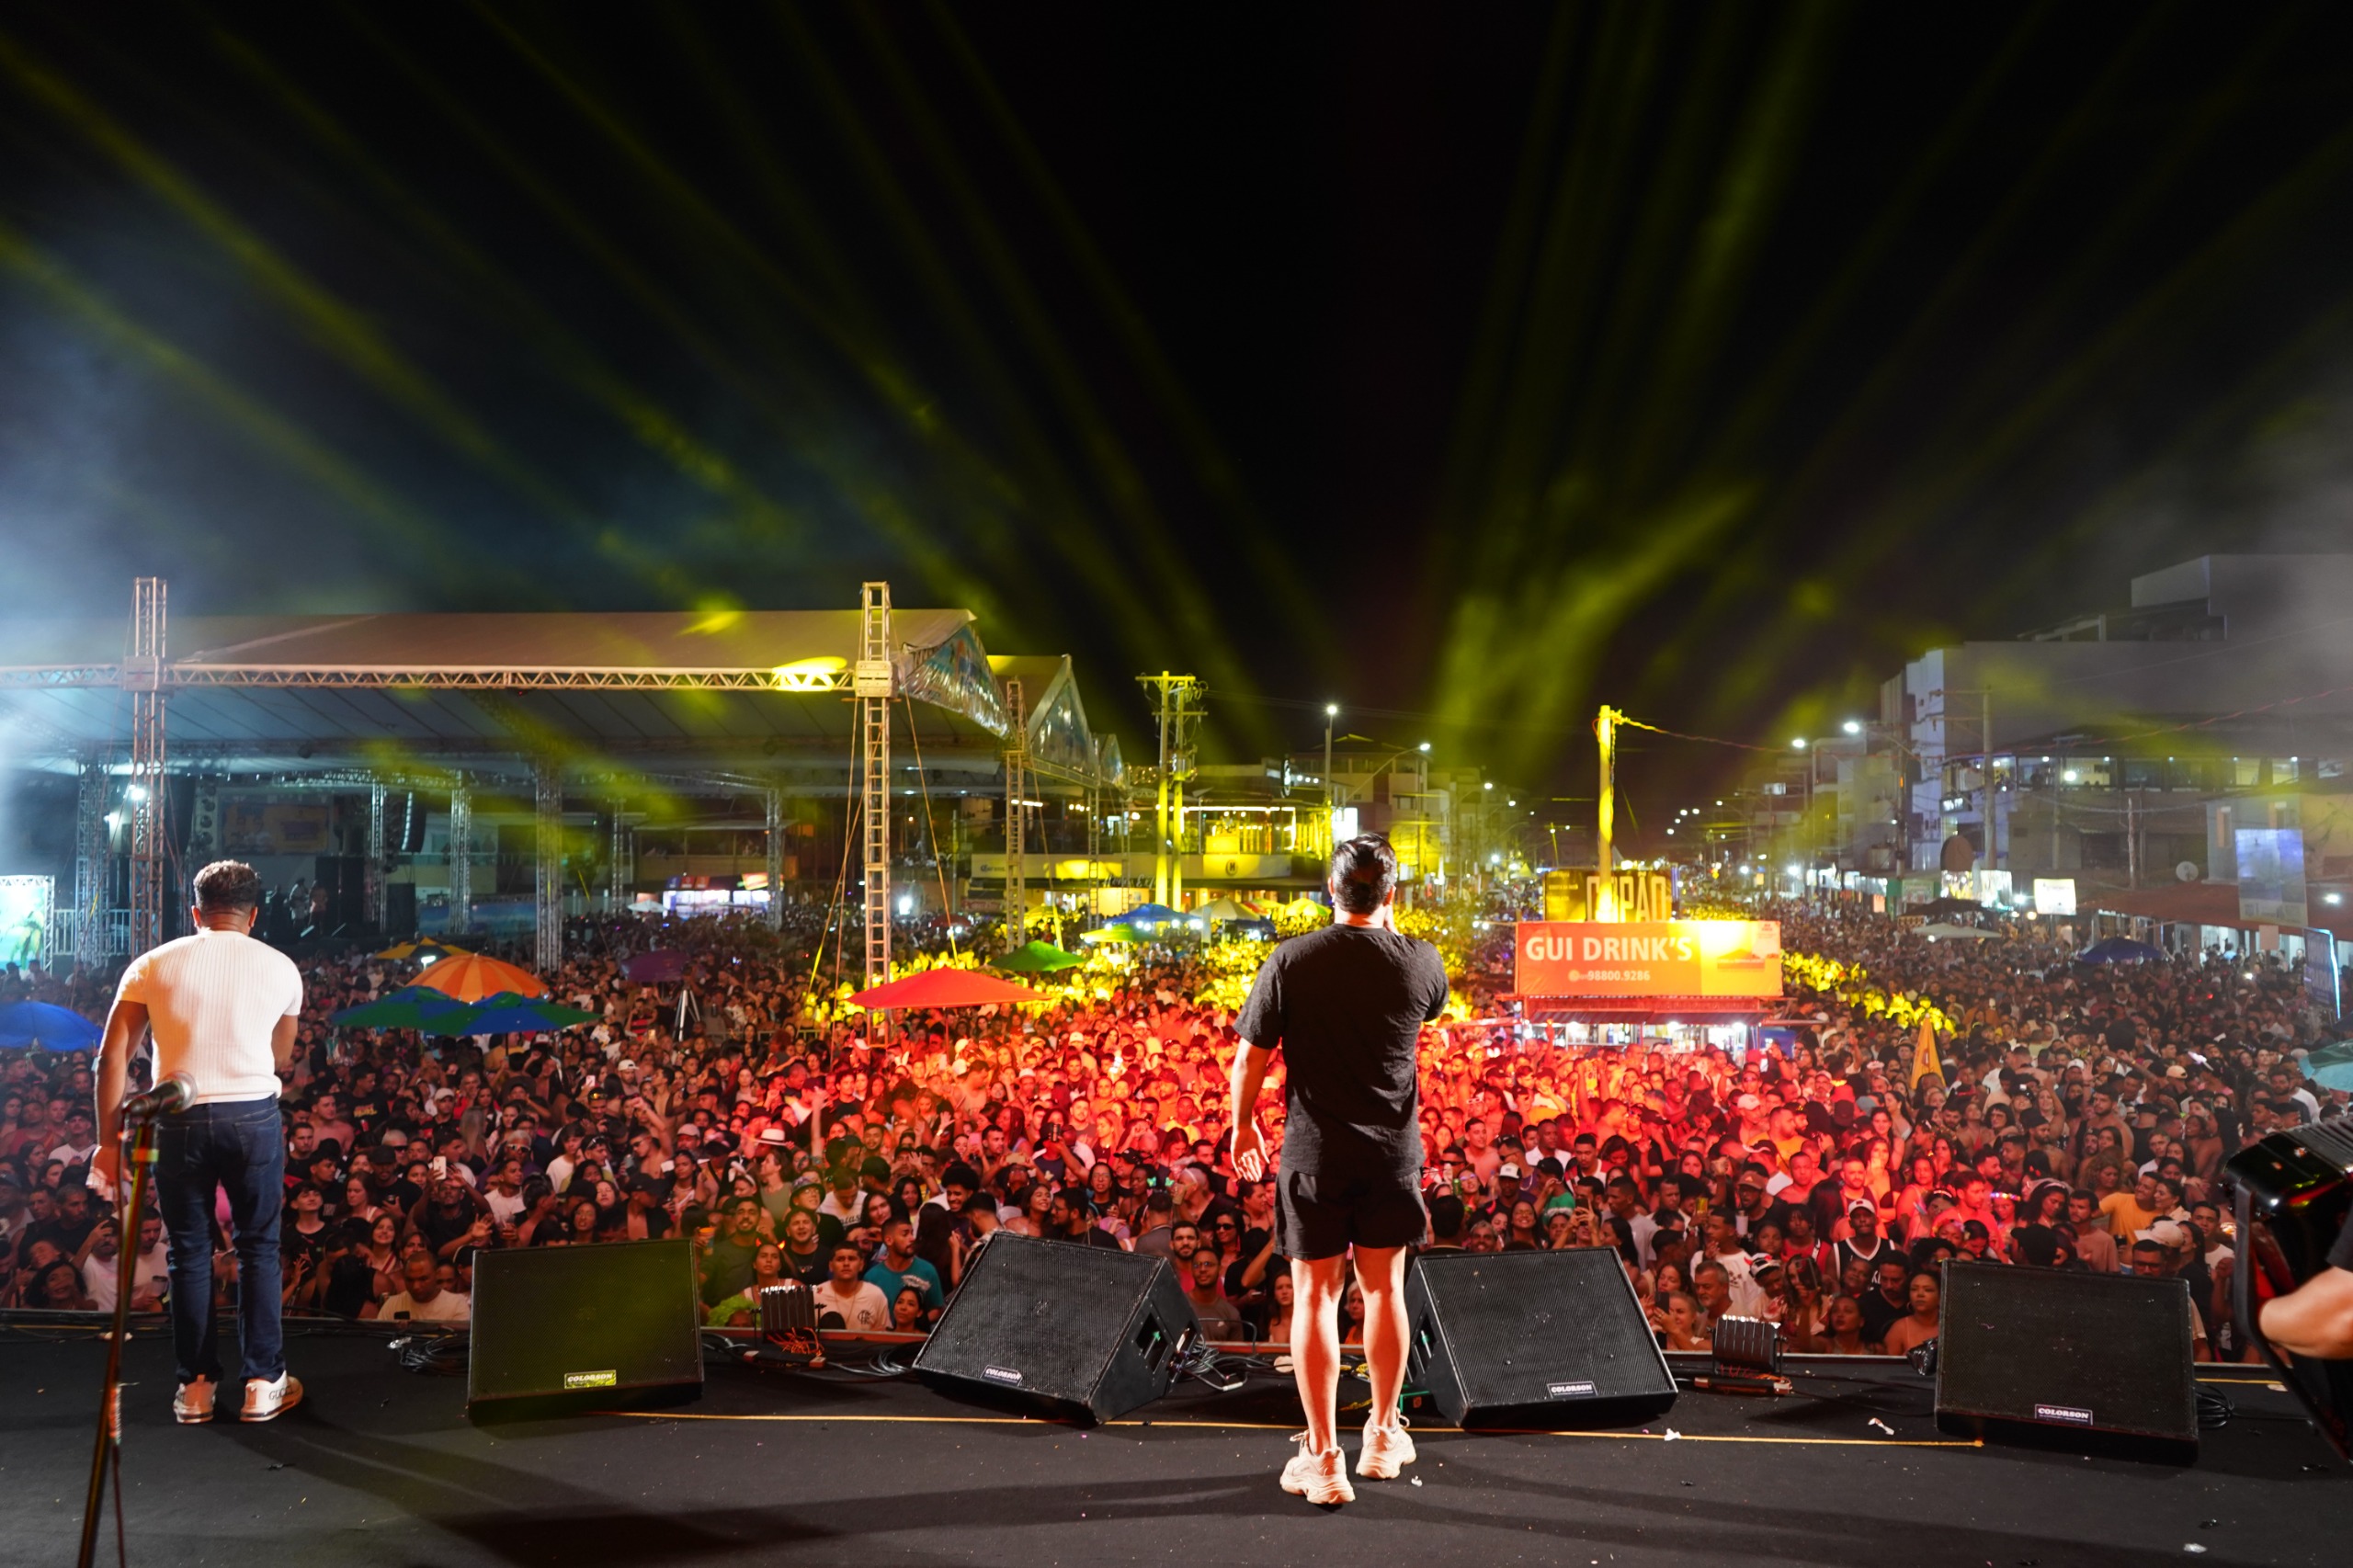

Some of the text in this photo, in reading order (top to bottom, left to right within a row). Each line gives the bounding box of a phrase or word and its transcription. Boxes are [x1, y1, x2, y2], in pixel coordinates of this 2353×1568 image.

[1526, 937, 1573, 961] GUI
[1587, 970, 1651, 981] 98800.9286
[1551, 1384, 1592, 1392] COLORSON
[2038, 1407, 2089, 1419] COLORSON
